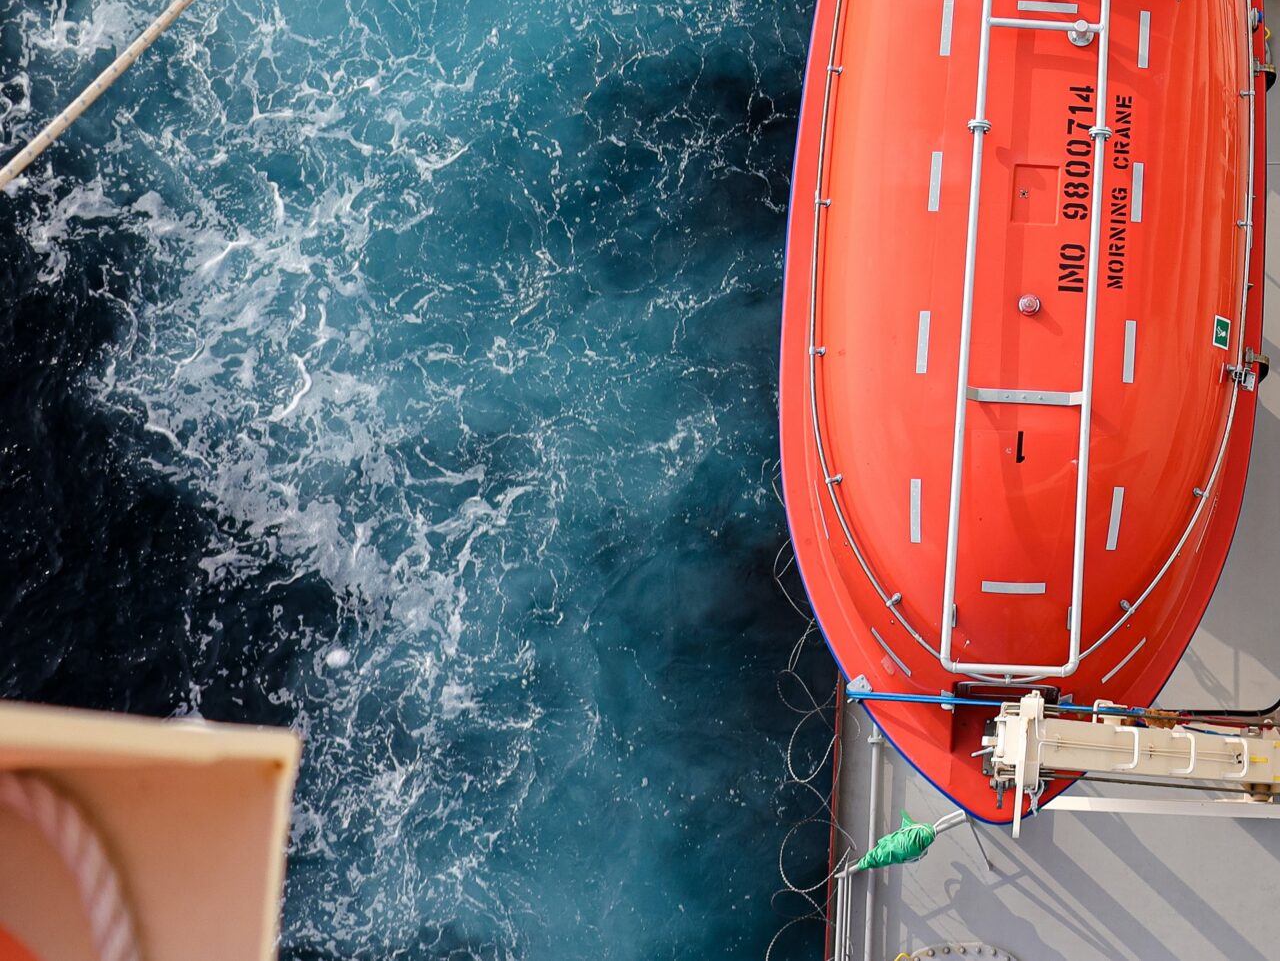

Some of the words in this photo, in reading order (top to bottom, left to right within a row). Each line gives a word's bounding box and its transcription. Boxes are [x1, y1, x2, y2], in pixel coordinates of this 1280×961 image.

[1063, 85, 1094, 221] 9800714
[1113, 94, 1133, 170] CRANE
[1058, 243, 1087, 293] IMO
[1107, 187, 1128, 290] MORNING
